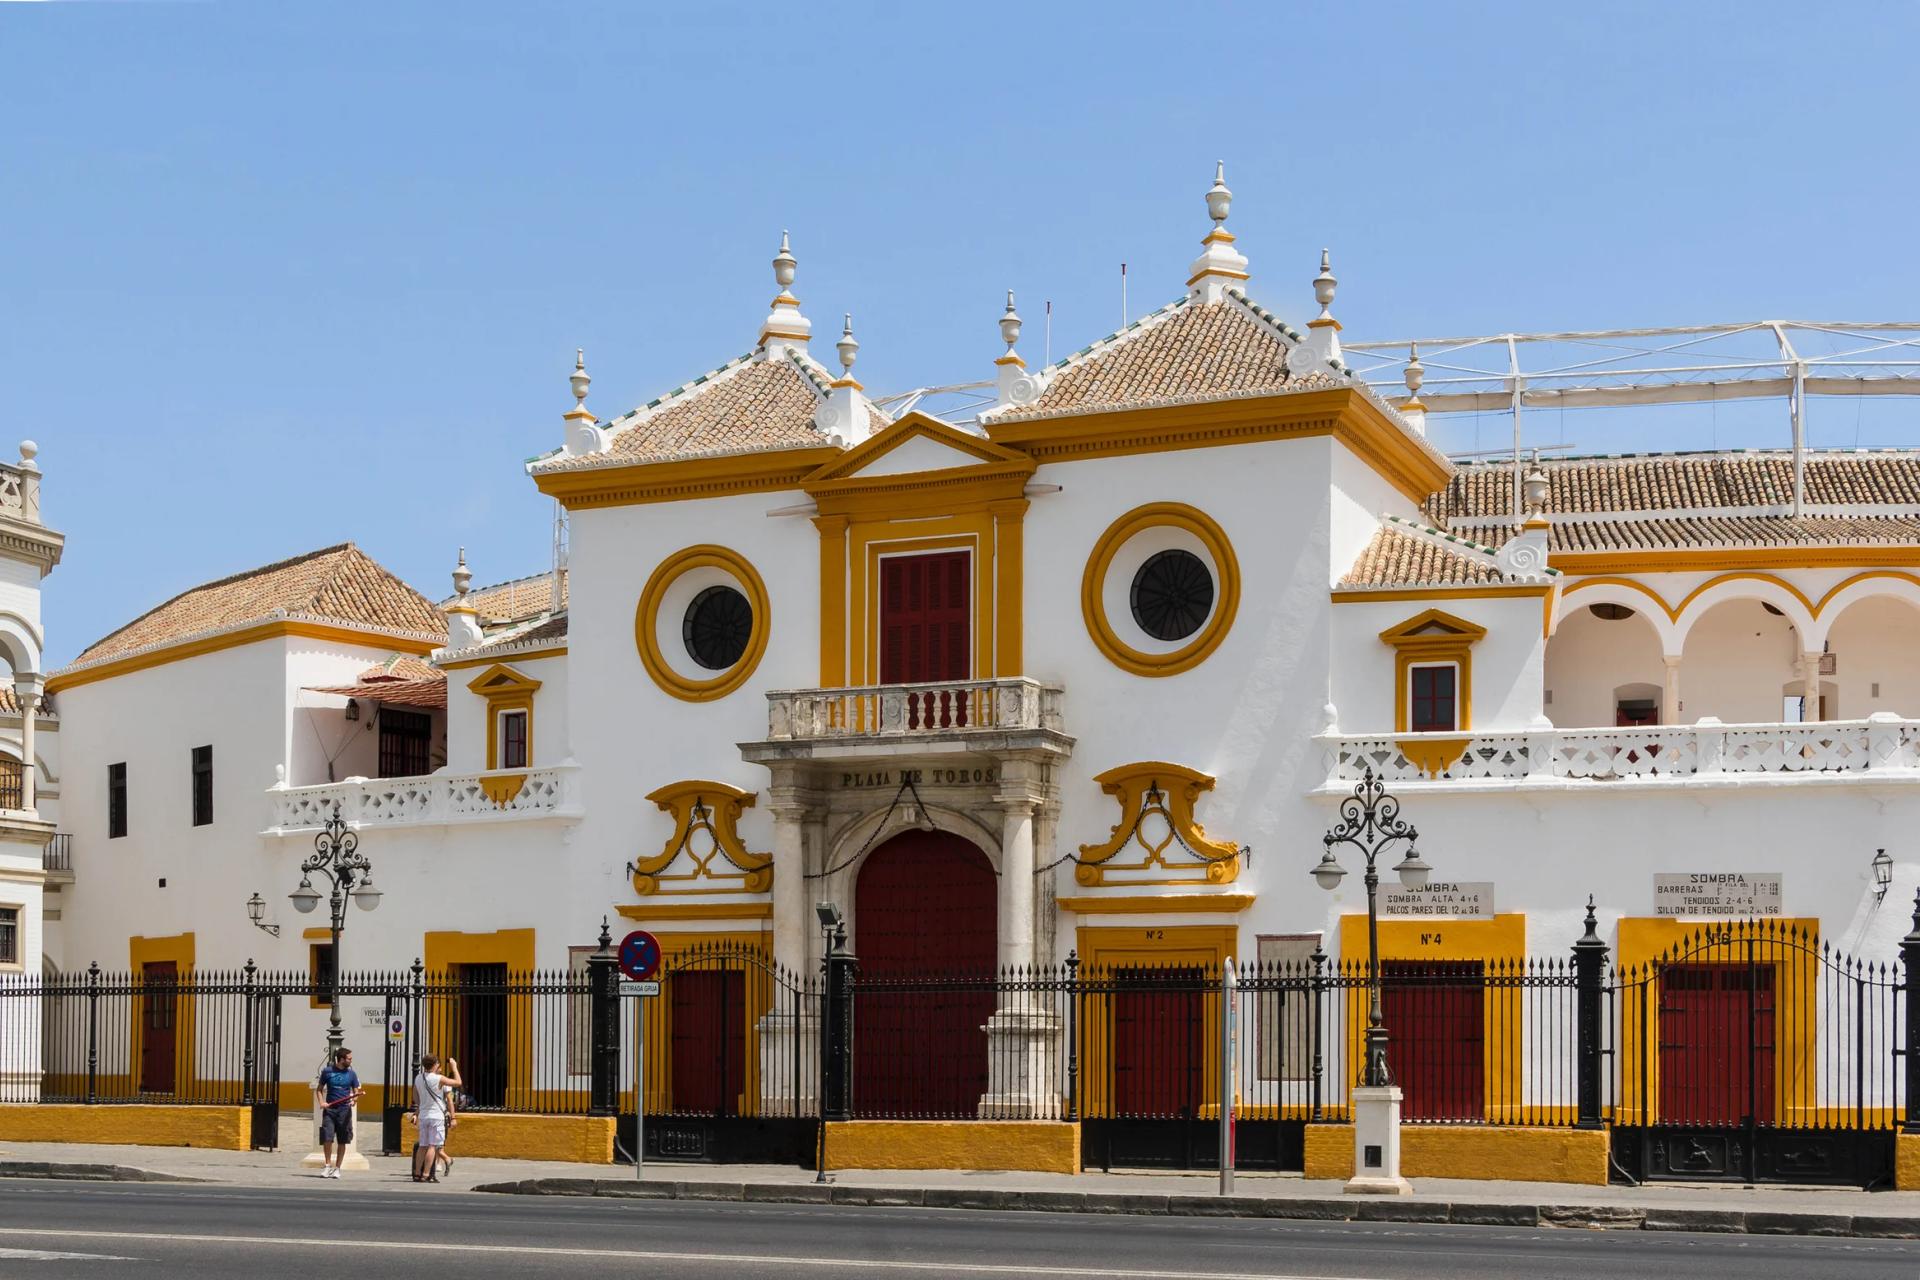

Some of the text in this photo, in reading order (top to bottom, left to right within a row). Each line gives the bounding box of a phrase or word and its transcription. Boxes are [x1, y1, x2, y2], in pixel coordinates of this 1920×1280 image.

[842, 771, 890, 787] PLAZA
[932, 769, 994, 783] TOROS
[1690, 874, 1745, 883] SOMBRA
[1657, 885, 1703, 894] BARRERAS
[1387, 895, 1422, 903] SOMBRA
[1431, 895, 1454, 903] ALTA
[1460, 895, 1466, 903] 4
[1473, 895, 1479, 903] 6
[1683, 897, 1720, 905] TENDIDOS
[1386, 906, 1409, 915] PALCOS
[1411, 906, 1433, 914] PARES
[1436, 906, 1449, 914] DEL
[1451, 906, 1459, 914] 12
[1469, 906, 1480, 914] 36
[1657, 906, 1685, 914] SILLON
[1688, 906, 1699, 914] DE
[1702, 906, 1734, 914] TENDIDO
[1749, 906, 1754, 914] 2
[1765, 906, 1778, 914] 156
[1157, 930, 1164, 940] 2
[1434, 933, 1442, 945] 4
